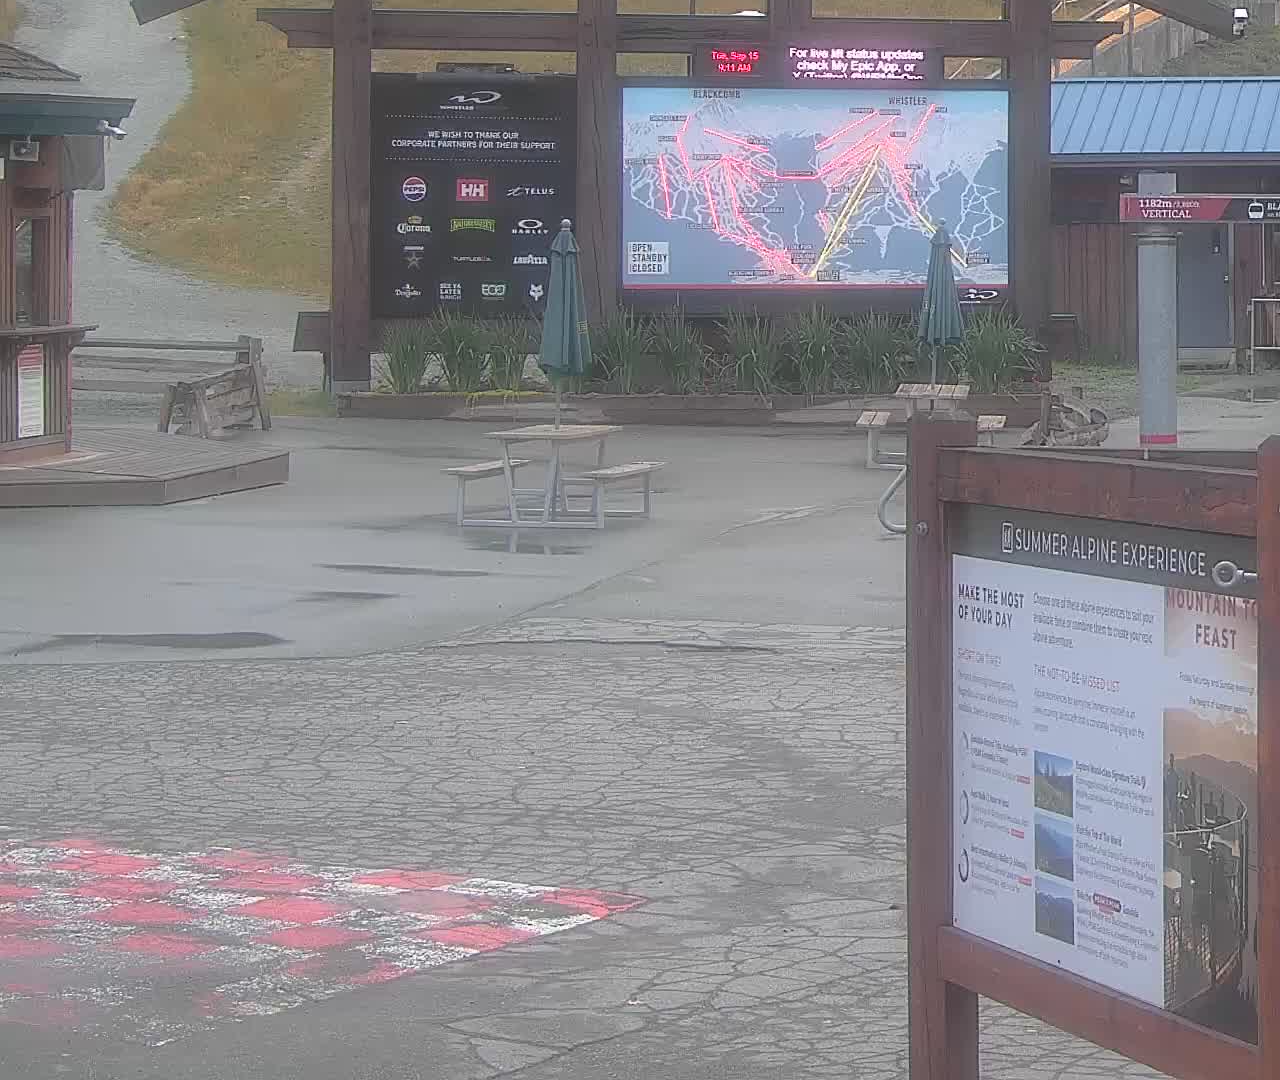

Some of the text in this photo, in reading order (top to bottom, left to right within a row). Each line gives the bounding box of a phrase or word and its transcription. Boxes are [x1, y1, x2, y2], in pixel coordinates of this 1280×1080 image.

[790, 48, 808, 57] For
[810, 48, 828, 58] live
[846, 48, 878, 59] status
[881, 50, 923, 60] updates
[797, 61, 828, 70] check
[832, 61, 848, 72] My
[851, 61, 874, 72] Epic
[904, 63, 915, 71] or
[693, 90, 740, 98] BLACKCOMB
[888, 96, 928, 105] WHISTLER
[475, 131, 500, 139] THANK
[392, 139, 436, 147] CORPORATE
[437, 140, 477, 148] PARTNERS
[461, 183, 484, 197] HH
[1139, 199, 1172, 207] 1182m
[1142, 210, 1192, 218] VERTICAL
[397, 223, 431, 233] Corona
[632, 243, 652, 251] OPEN
[632, 254, 667, 262] STANDBY
[630, 264, 662, 272] CLOSED
[1014, 528, 1206, 577] SUMMER ALPINE EXPERIENCE
[958, 583, 1024, 610] MAKE THE MOST
[958, 604, 1013, 630] OF YOUR DAY
[1195, 623, 1237, 649] FEAST
[1034, 664, 1046, 677] THE
